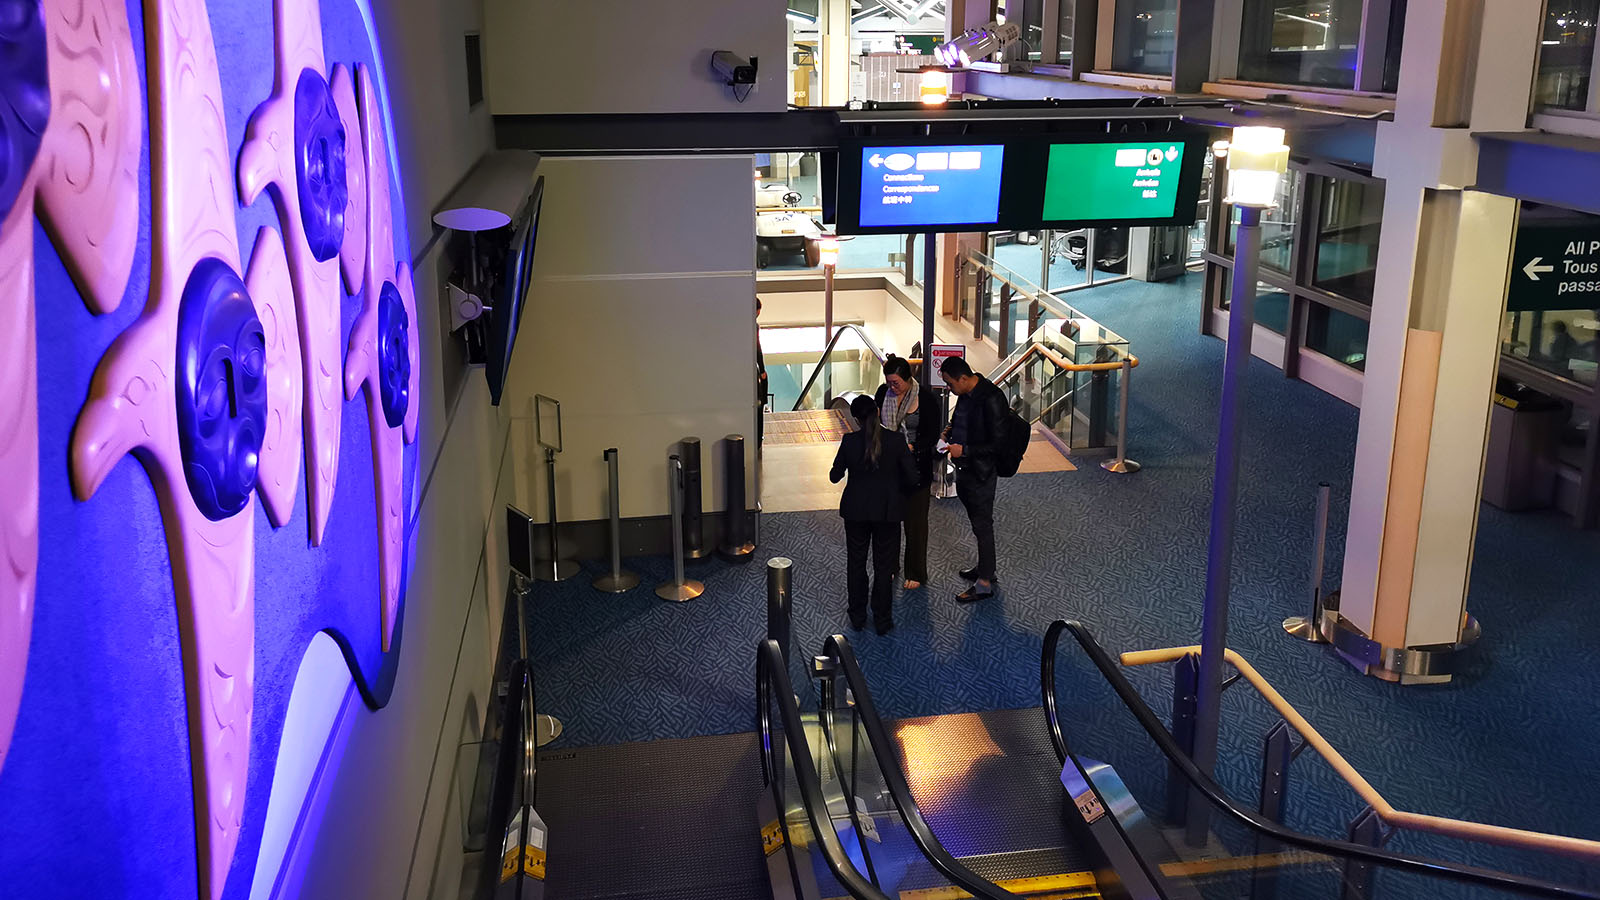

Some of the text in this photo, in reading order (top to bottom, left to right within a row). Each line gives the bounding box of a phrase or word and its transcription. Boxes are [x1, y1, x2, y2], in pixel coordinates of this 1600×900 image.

[1565, 241, 1585, 255] All
[1562, 260, 1598, 274] Tous
[1558, 281, 1600, 295] passa
